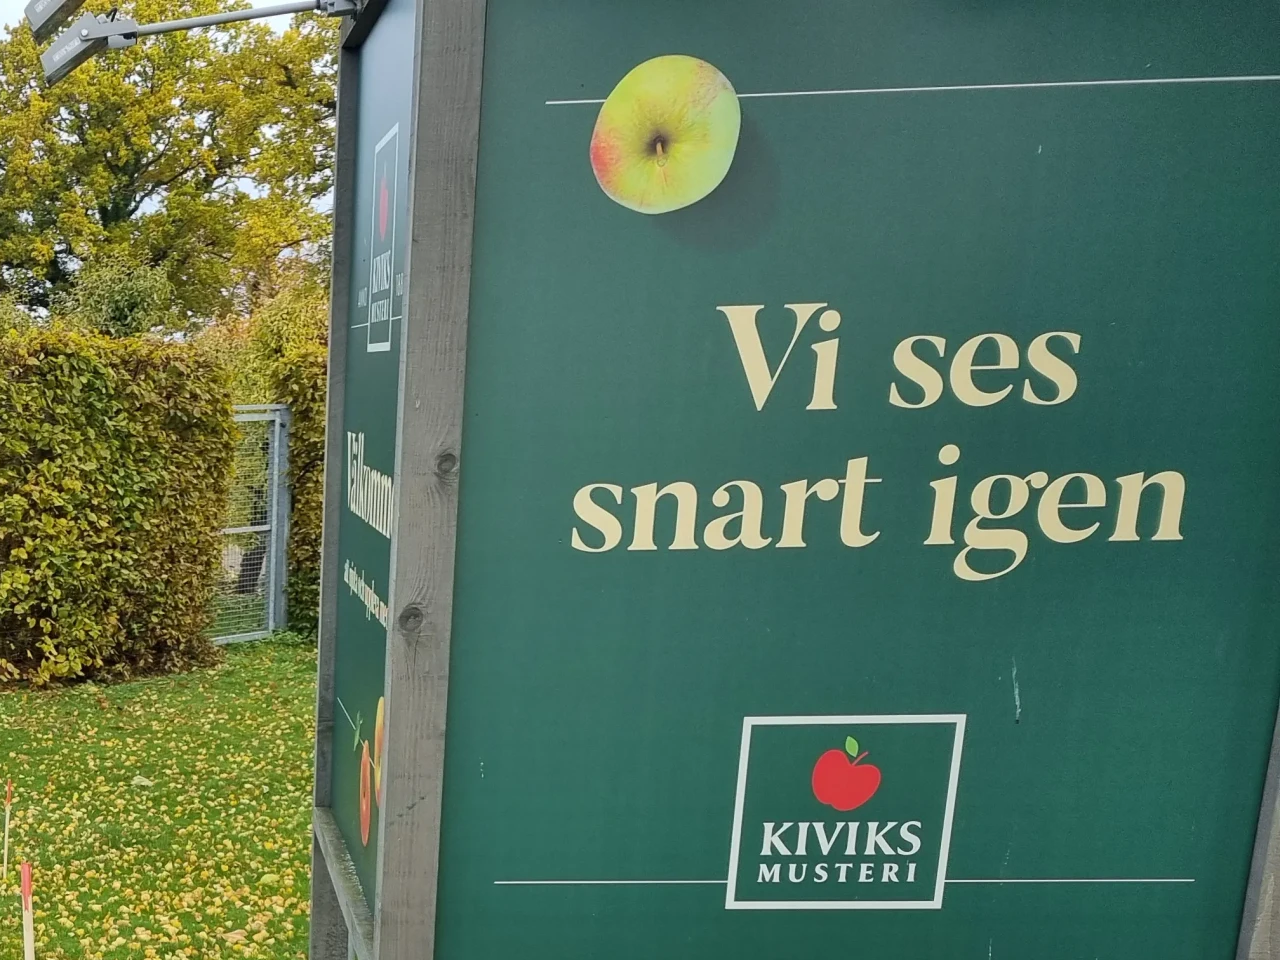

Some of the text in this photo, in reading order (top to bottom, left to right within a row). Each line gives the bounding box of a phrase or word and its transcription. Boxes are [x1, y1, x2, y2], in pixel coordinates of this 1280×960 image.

[716, 303, 1081, 411] Vi ses
[347, 431, 395, 539] Välkomm
[571, 444, 1185, 581] snart igen
[757, 863, 916, 882] MUSTERI
[760, 821, 921, 855] KIVIKS
